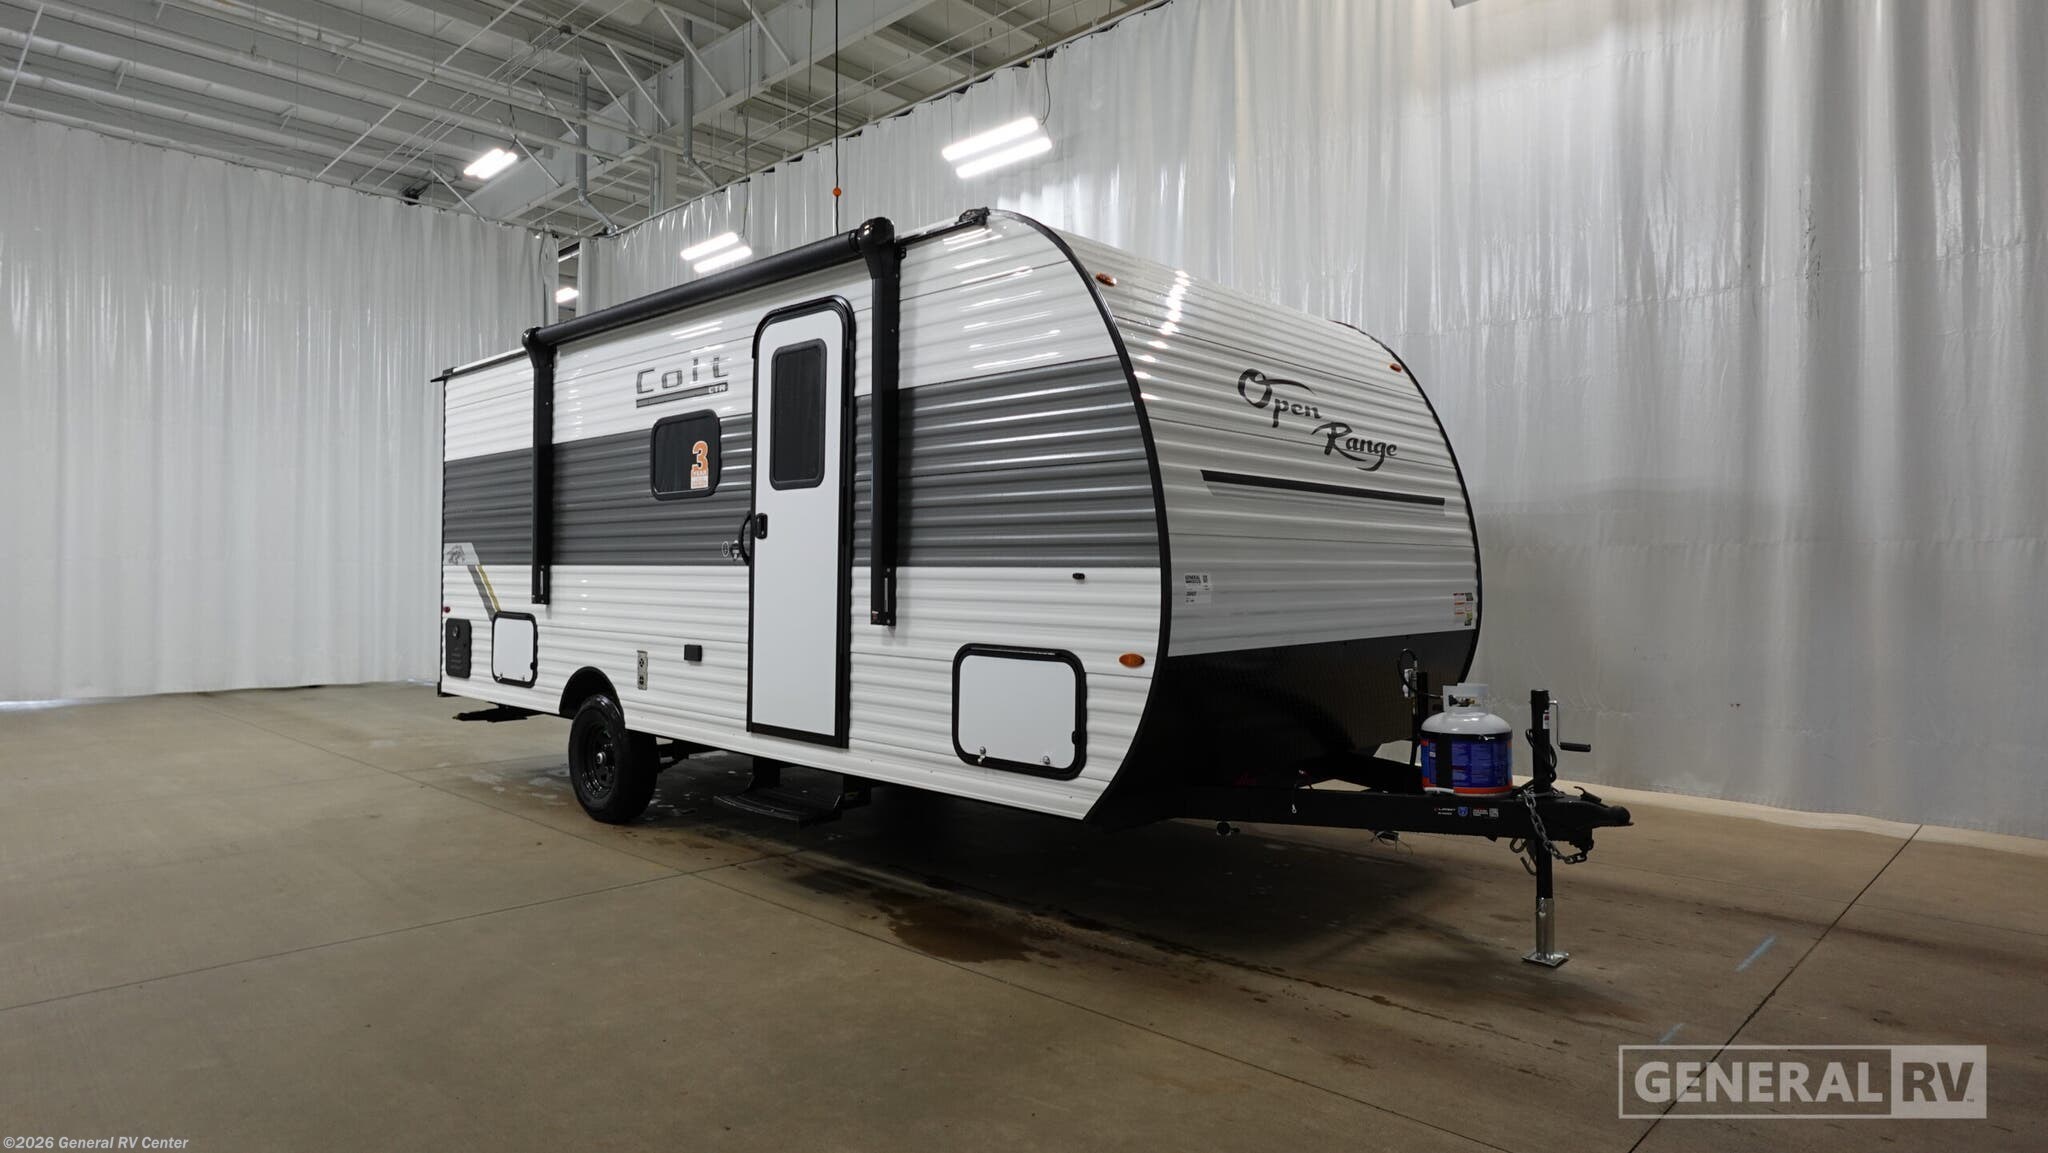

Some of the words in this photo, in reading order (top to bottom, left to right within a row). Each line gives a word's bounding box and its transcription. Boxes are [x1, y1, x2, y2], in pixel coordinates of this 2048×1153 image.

[1237, 368, 1323, 428] Open
[692, 440, 709, 472] 3
[1311, 421, 1398, 472] Range
